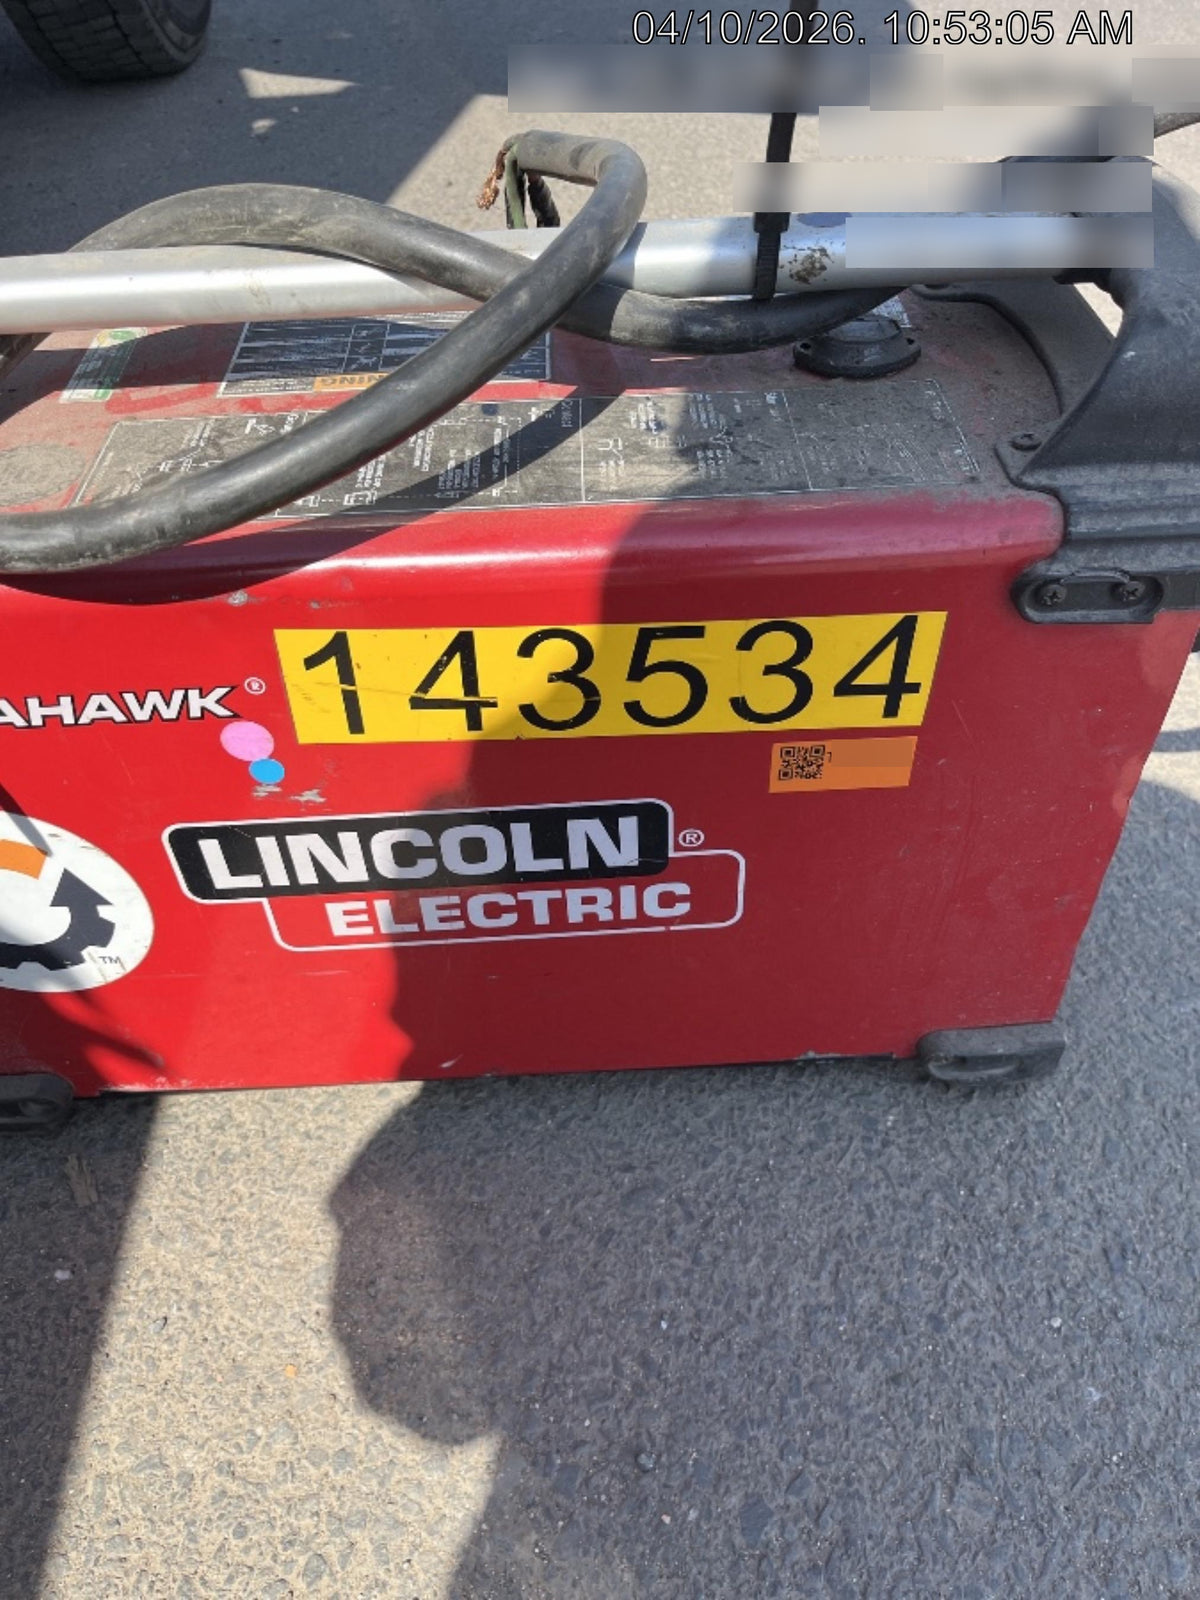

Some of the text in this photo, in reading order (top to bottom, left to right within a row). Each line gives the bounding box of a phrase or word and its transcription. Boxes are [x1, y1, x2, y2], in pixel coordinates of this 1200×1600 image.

[303, 614, 921, 735] 143534
[198, 815, 640, 890] LINCOLN
[326, 882, 692, 937] ELECTRIC
